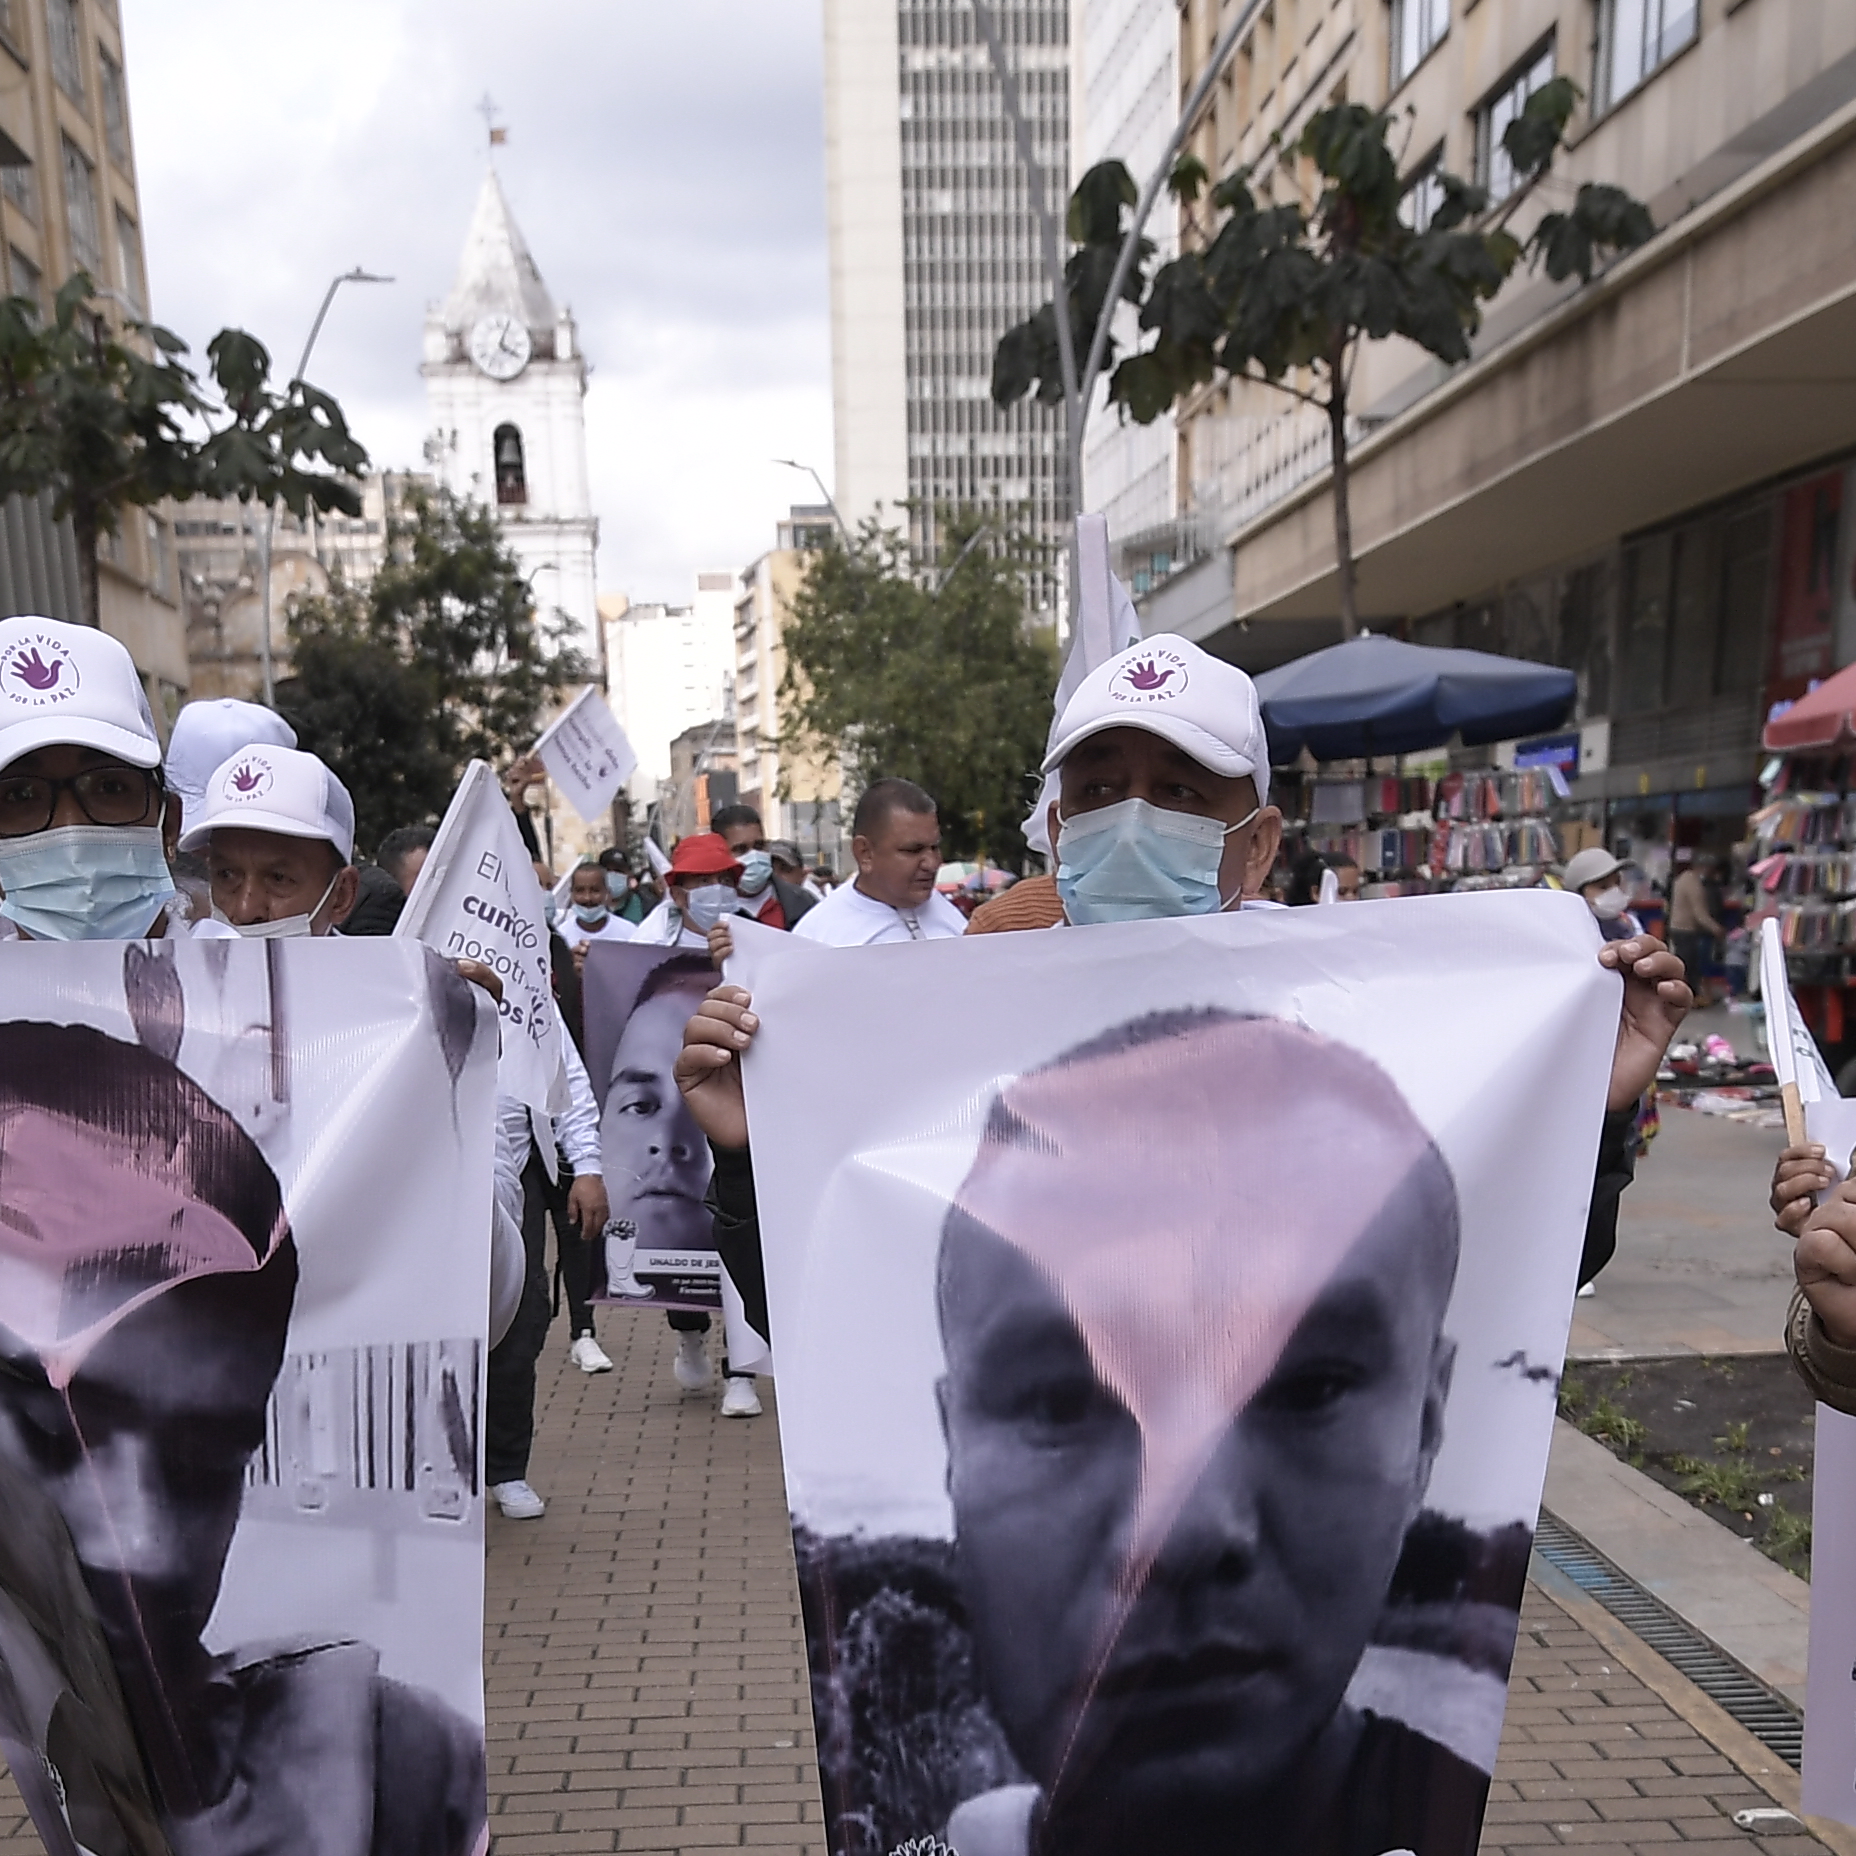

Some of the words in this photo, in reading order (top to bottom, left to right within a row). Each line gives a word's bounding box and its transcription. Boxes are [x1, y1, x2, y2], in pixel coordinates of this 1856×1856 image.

[36, 634, 69, 657] VIDA
[1158, 650, 1186, 667] VIDA
[50, 687, 76, 703] PAZ
[1148, 690, 1175, 702] PAZ
[476, 851, 502, 884] El
